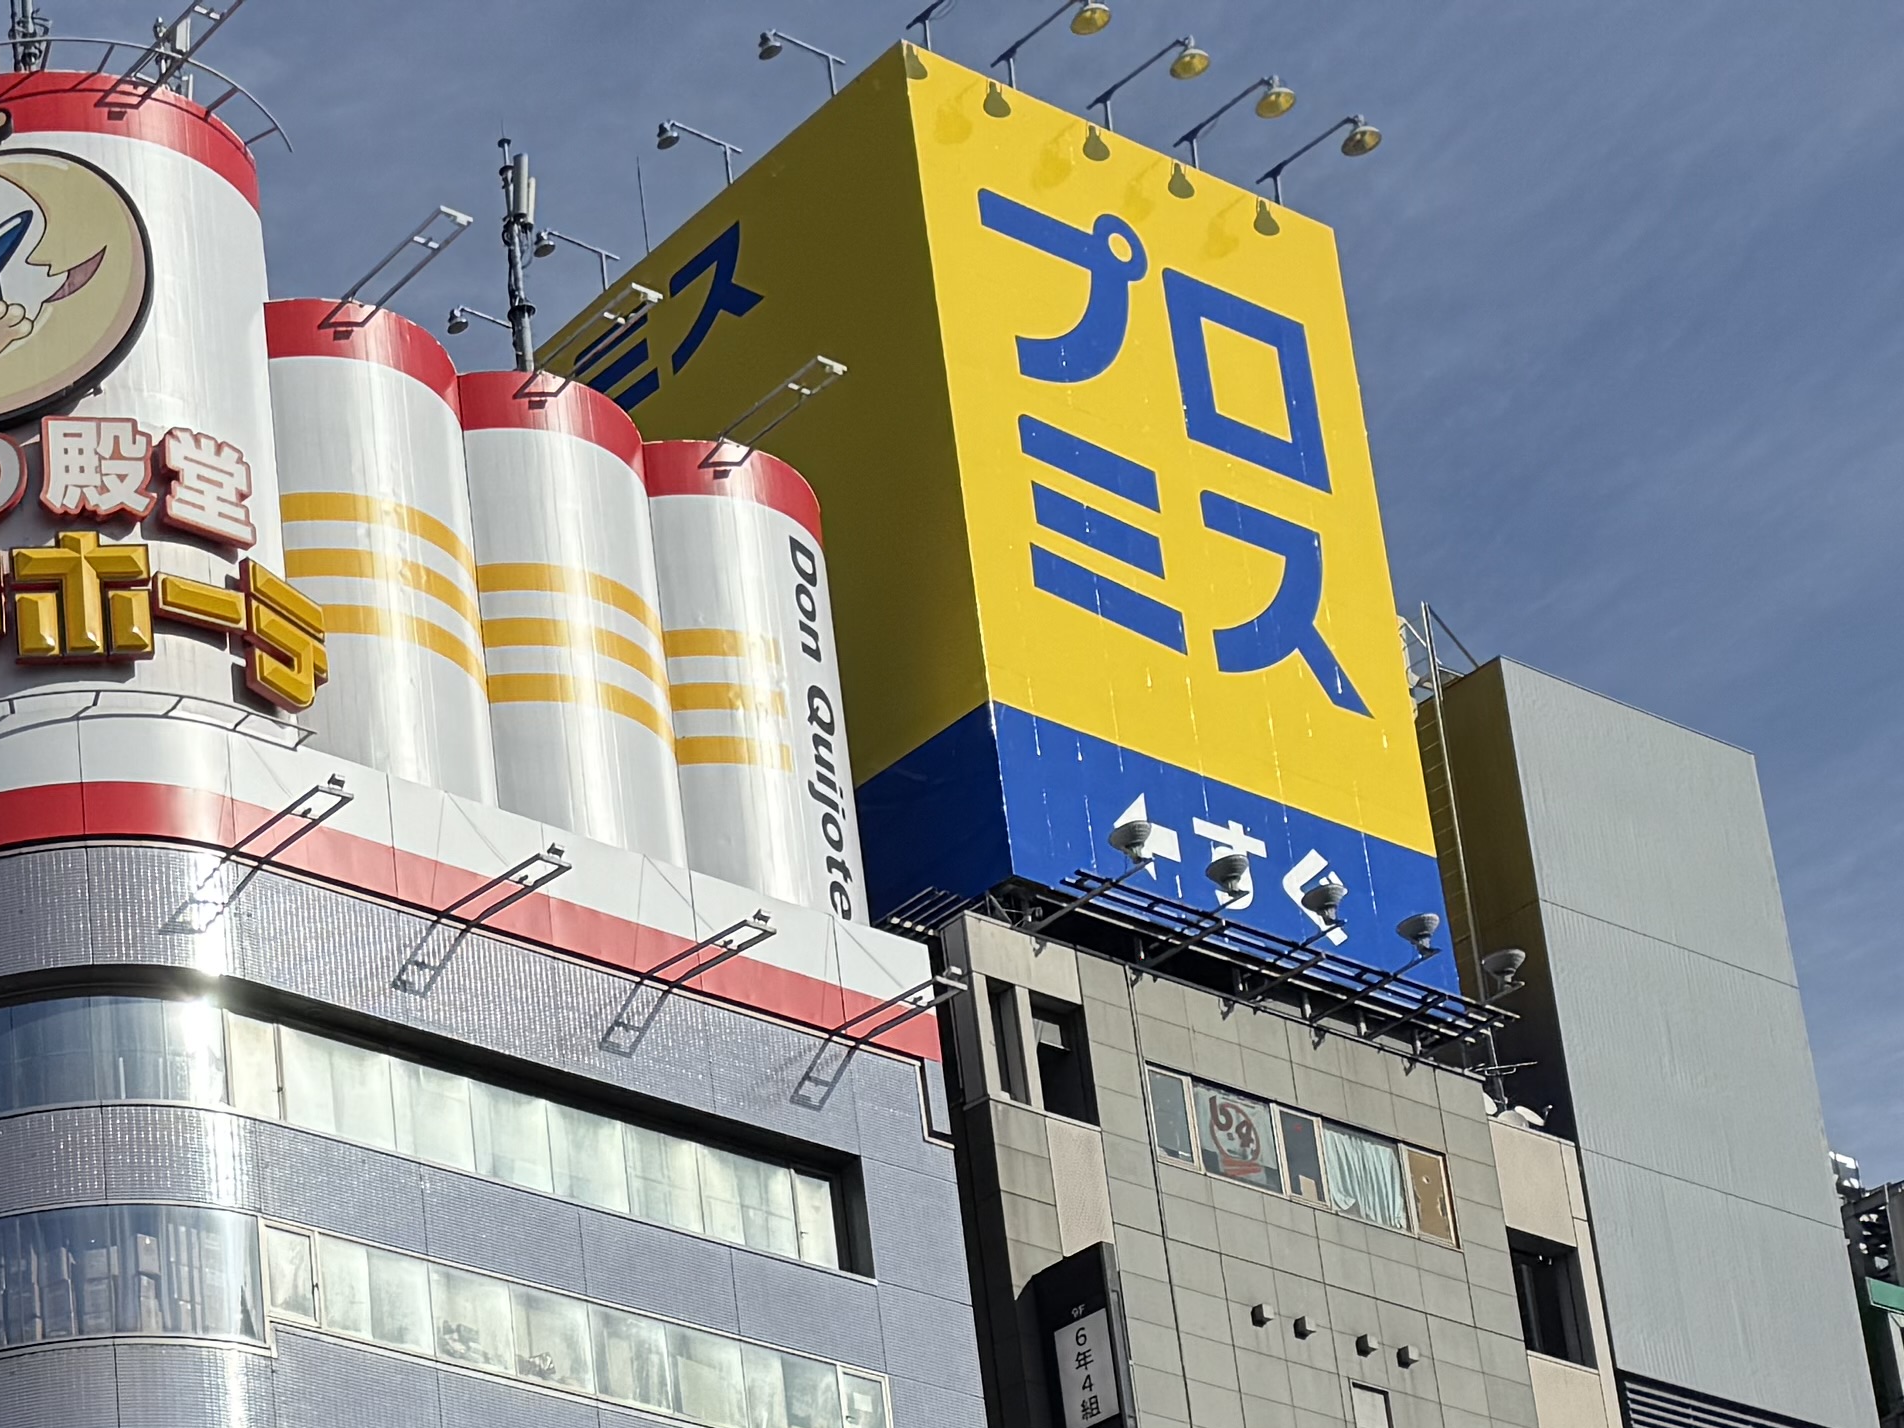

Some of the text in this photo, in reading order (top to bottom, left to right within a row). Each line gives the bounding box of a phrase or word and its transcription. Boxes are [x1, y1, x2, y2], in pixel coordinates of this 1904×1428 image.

[788, 535, 856, 924] Don Quijote
[1073, 1326, 1102, 1421] 6年4組
